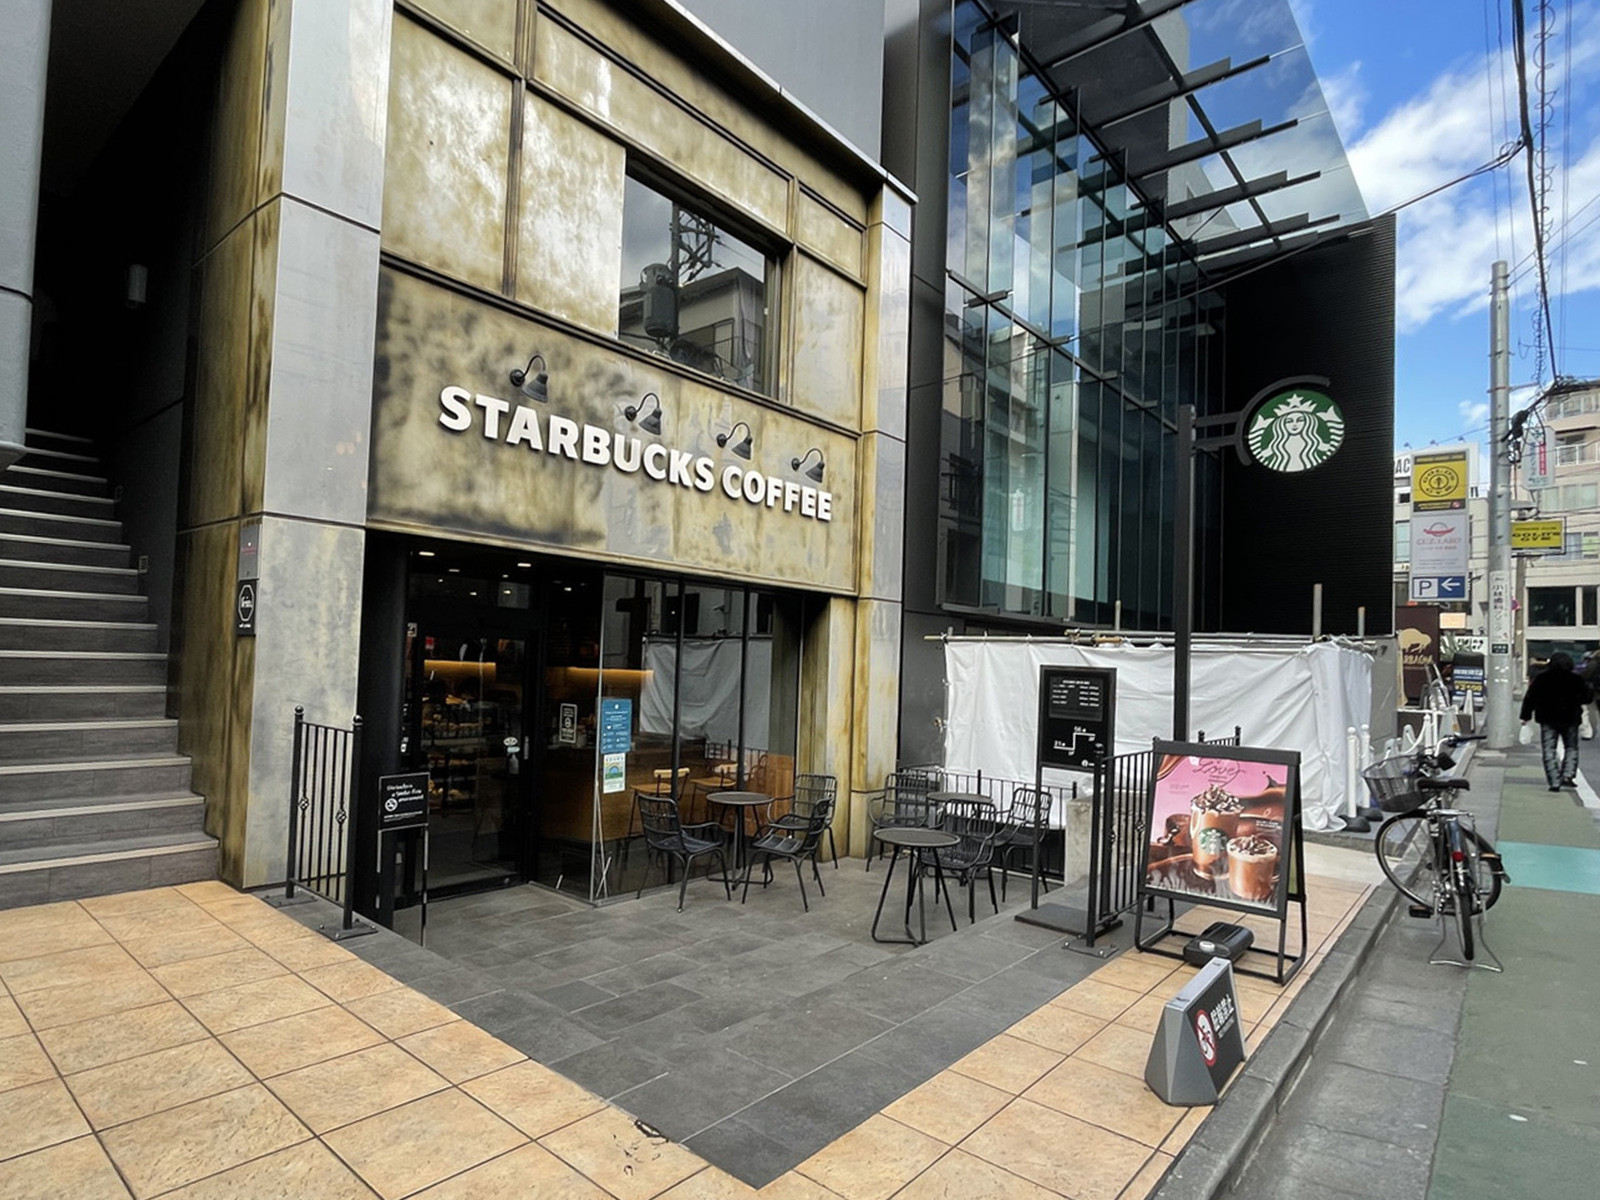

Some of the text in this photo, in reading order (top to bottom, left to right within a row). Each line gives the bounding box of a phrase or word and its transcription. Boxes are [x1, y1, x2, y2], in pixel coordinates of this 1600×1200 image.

[439, 385, 832, 521] STARBUCKS COFFEE
[1419, 580, 1432, 596] P
